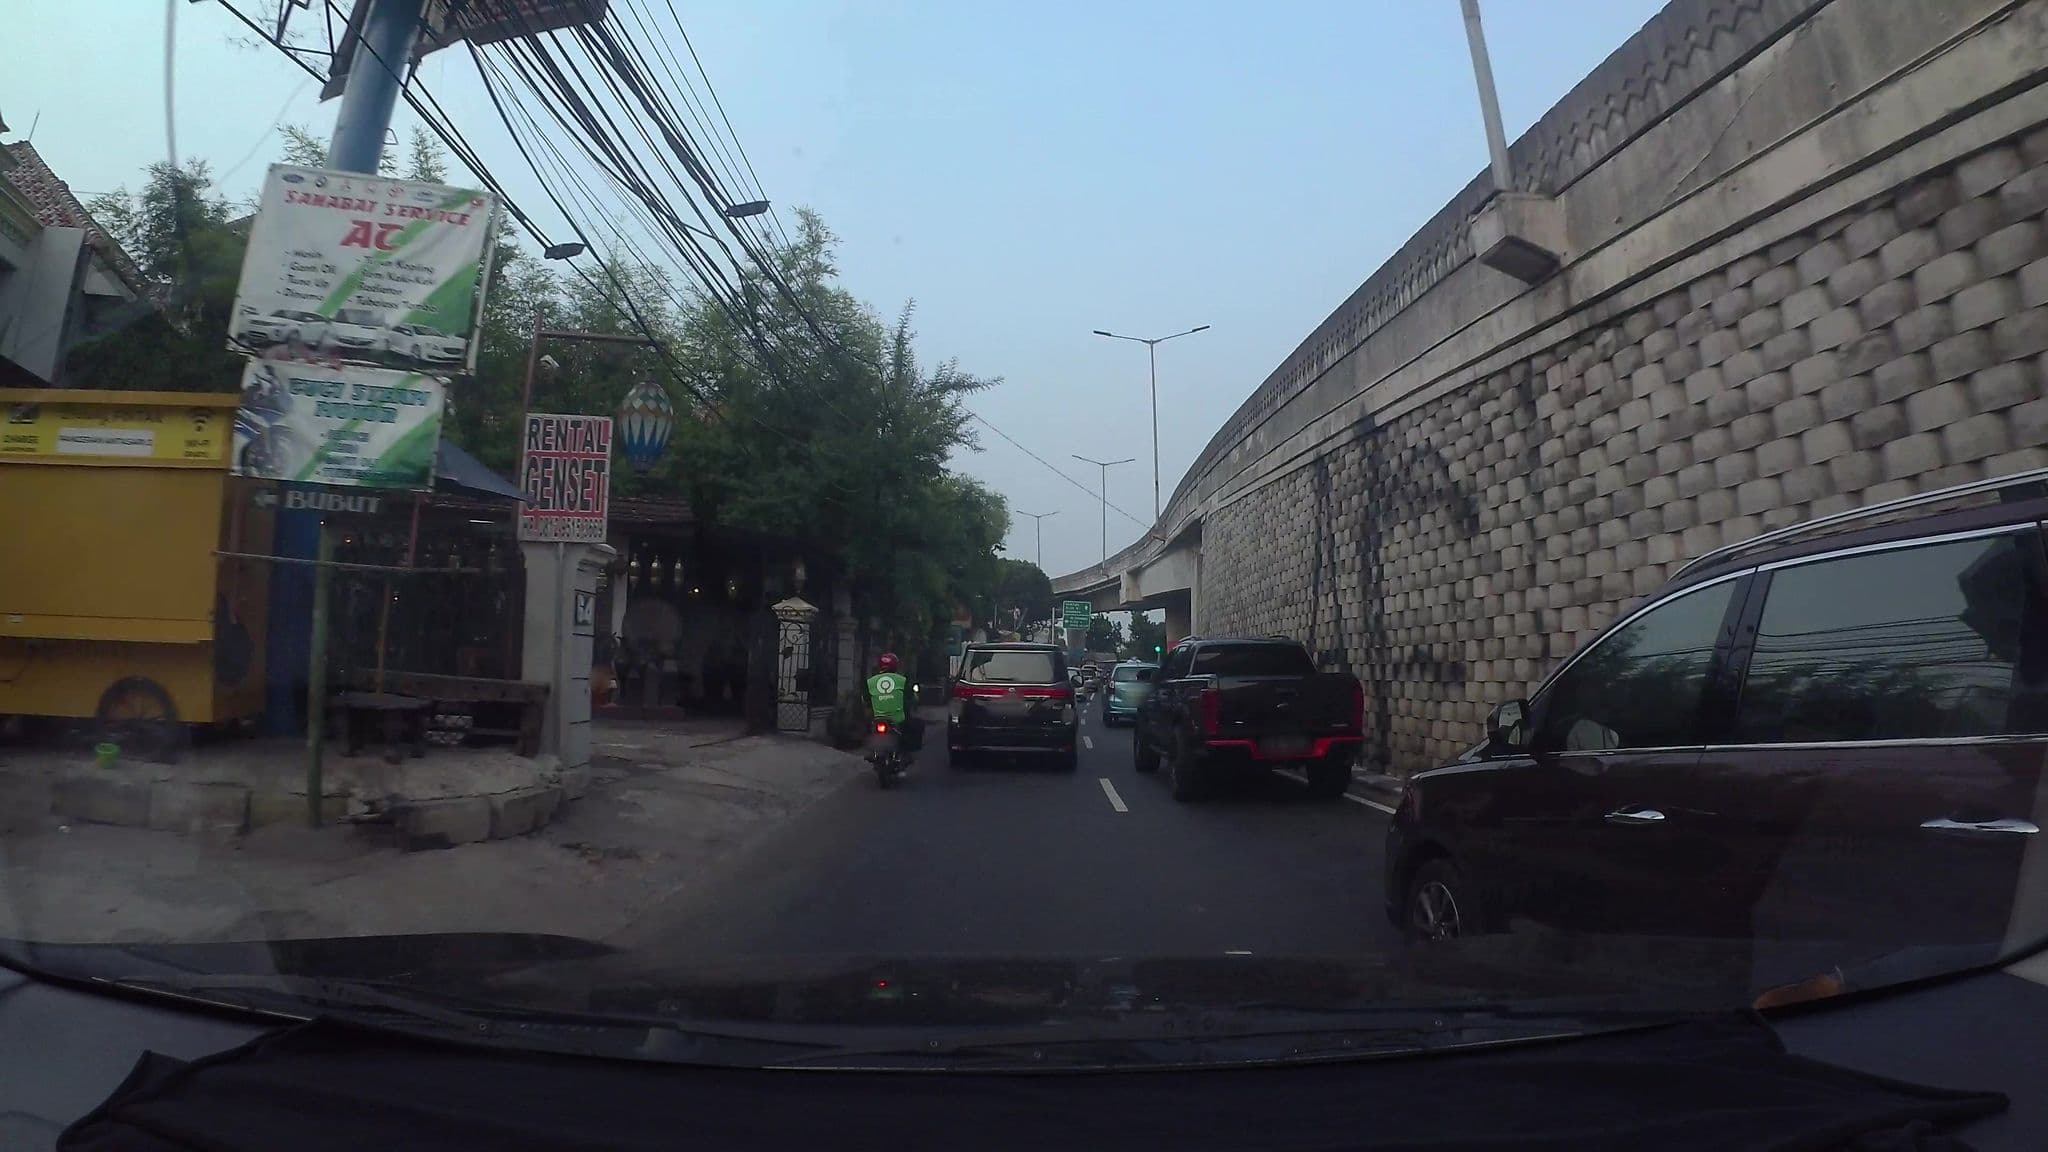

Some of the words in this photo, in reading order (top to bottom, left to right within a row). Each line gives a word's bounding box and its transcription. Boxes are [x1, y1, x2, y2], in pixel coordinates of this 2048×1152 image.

[383, 203, 470, 226] SERVICE
[340, 219, 405, 250] AC
[527, 417, 609, 453] RENTAL
[525, 456, 609, 512] GENSET
[285, 490, 383, 513] BUBUT
